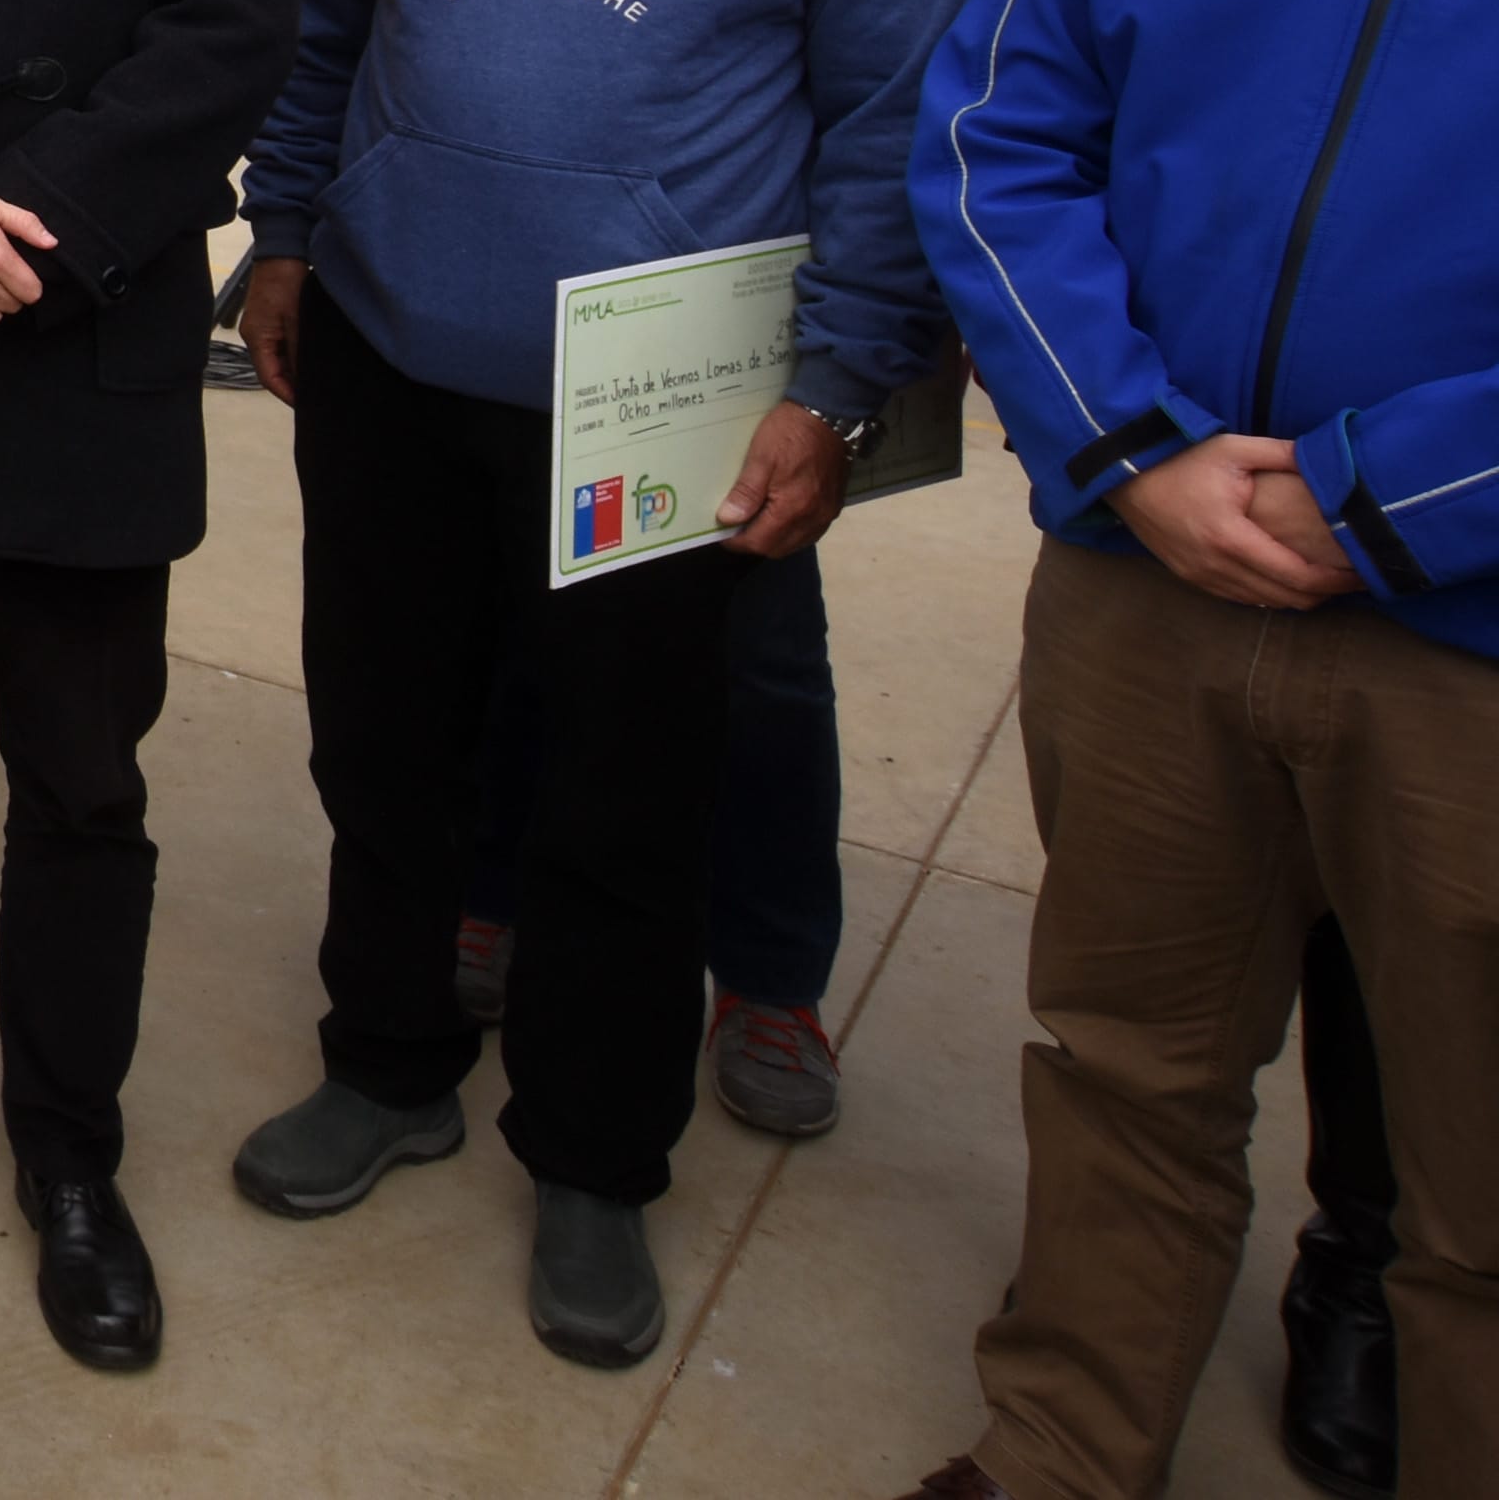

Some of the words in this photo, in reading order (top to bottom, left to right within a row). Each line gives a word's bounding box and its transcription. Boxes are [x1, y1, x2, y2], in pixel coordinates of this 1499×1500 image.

[610, 377, 640, 401] Junta
[643, 369, 655, 394] de
[660, 367, 700, 390] Vecinos
[706, 357, 743, 379] Lomas
[748, 347, 761, 370] de
[767, 344, 792, 367] San
[618, 402, 651, 423] Ocho
[658, 391, 705, 413] millones
